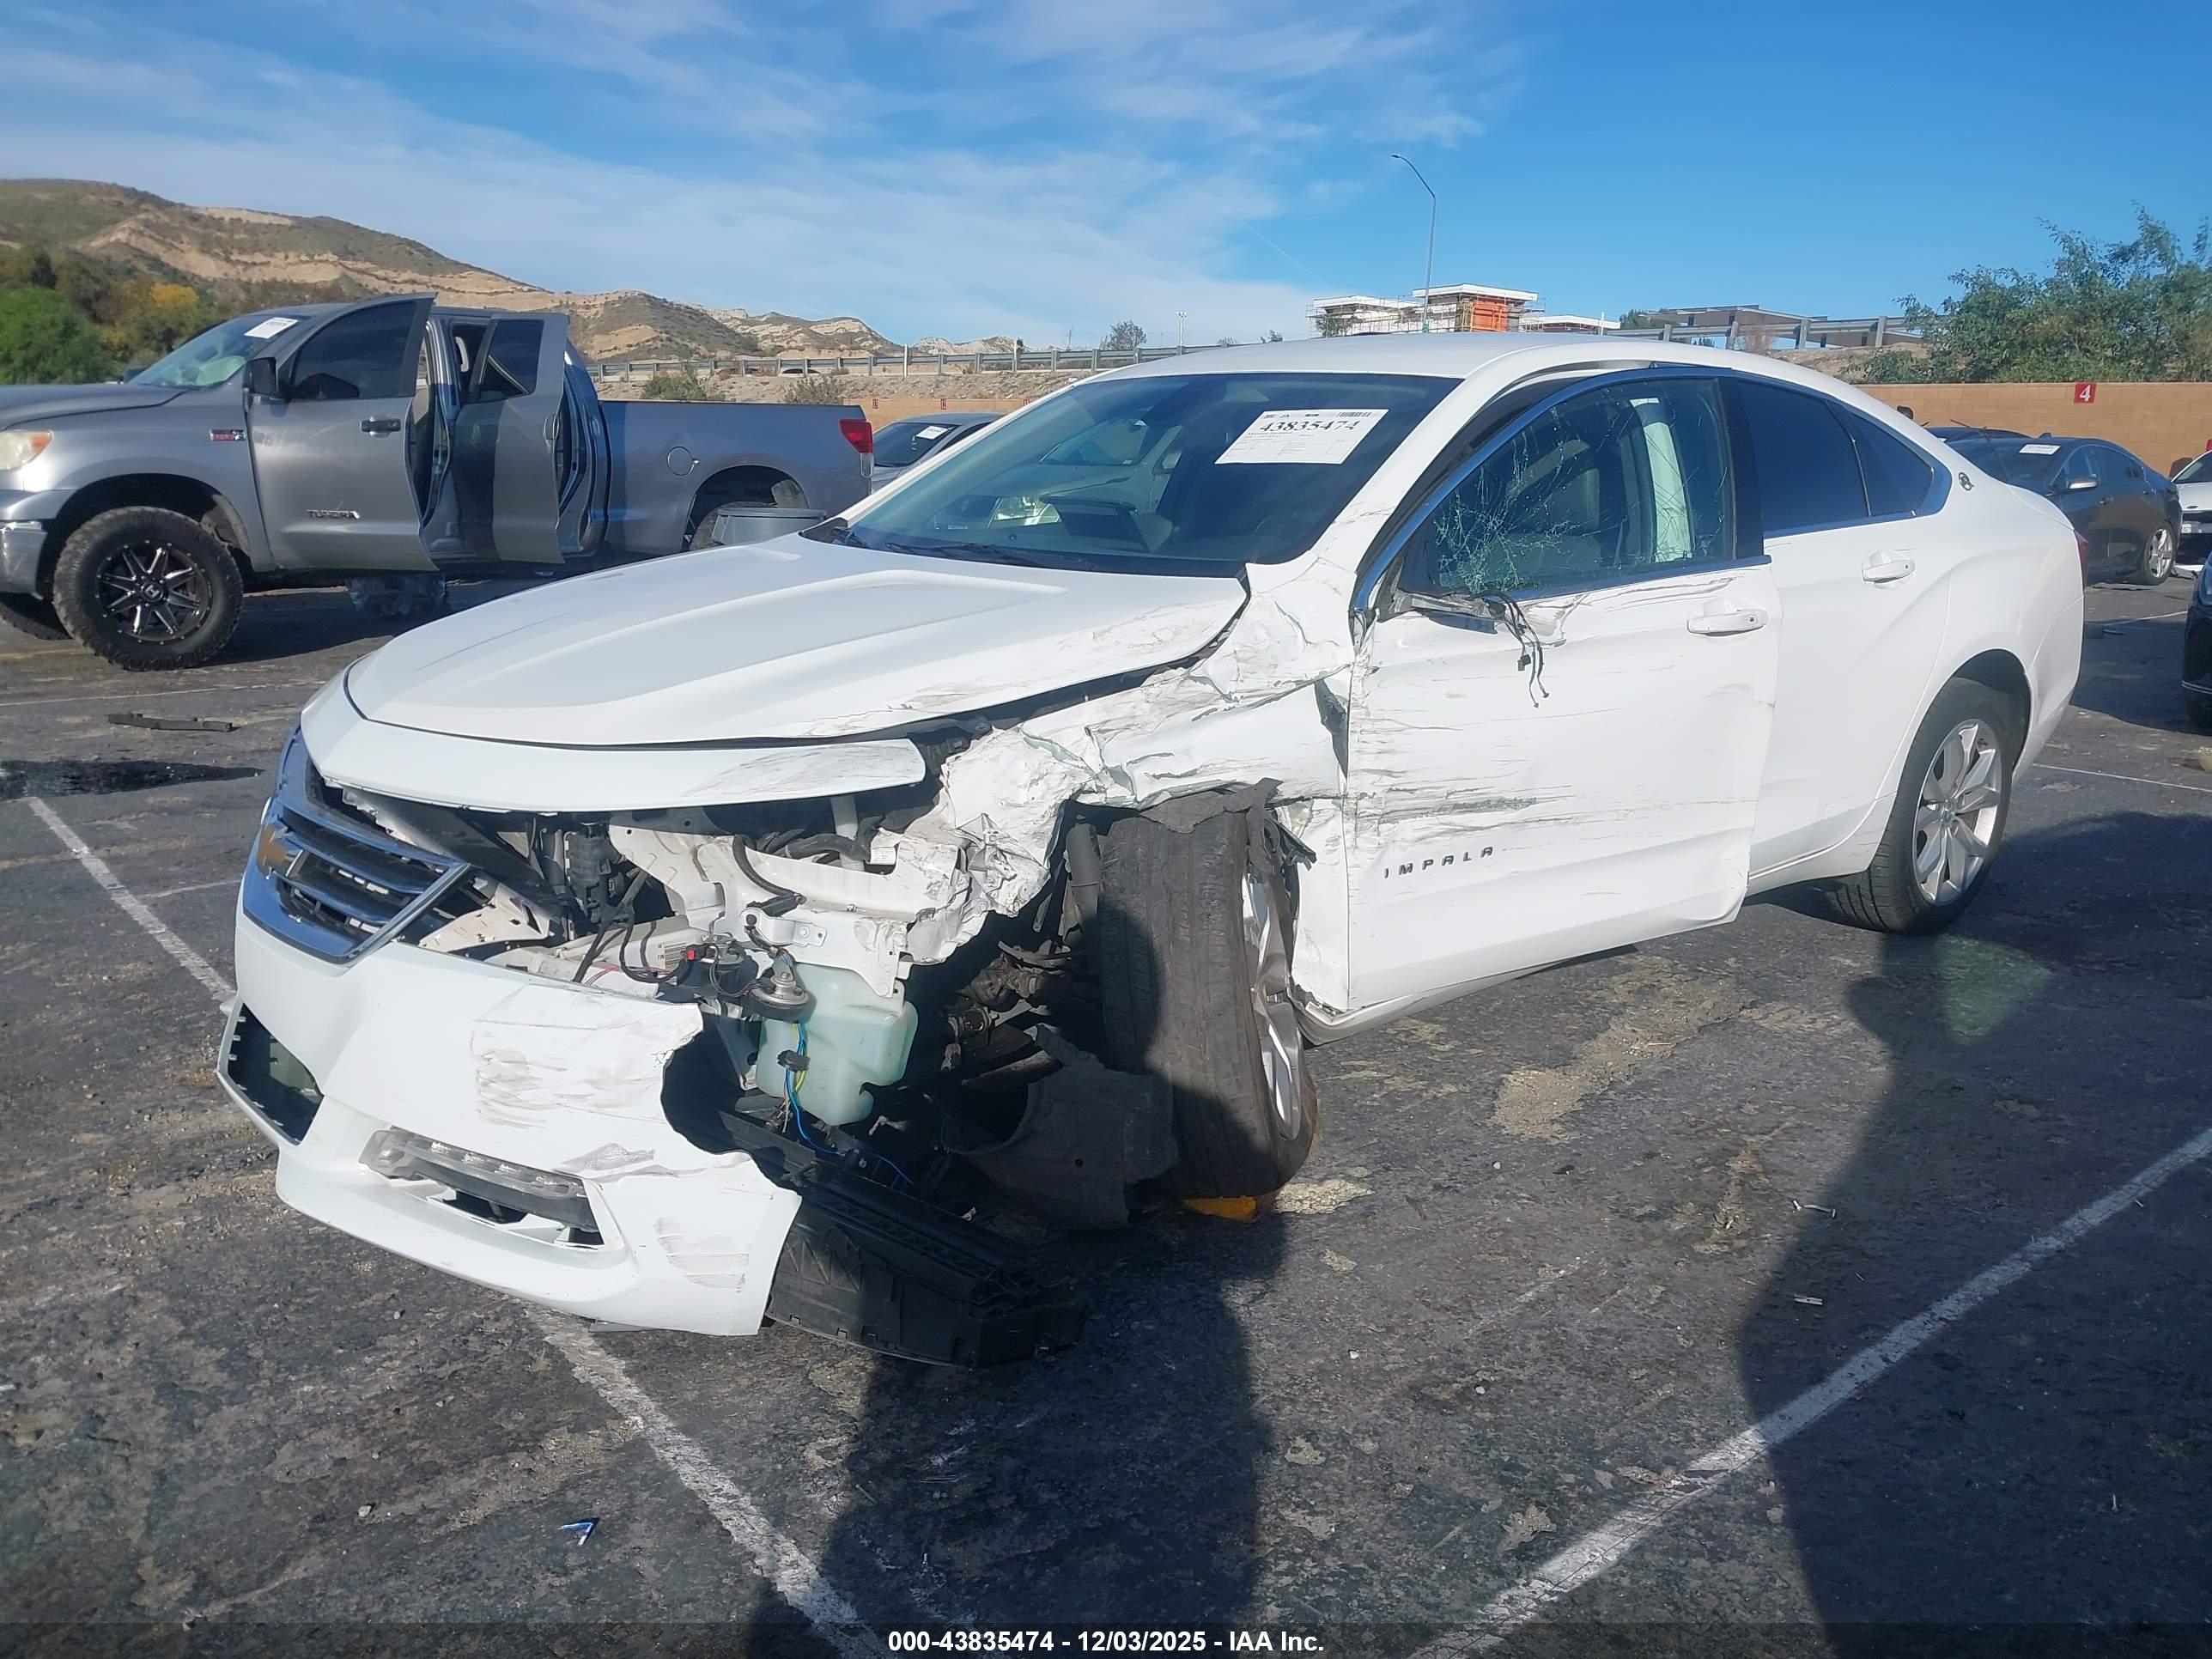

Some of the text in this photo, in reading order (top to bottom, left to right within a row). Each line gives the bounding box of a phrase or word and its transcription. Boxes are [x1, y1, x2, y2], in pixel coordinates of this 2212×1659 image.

[2079, 384, 2091, 402] 4
[1260, 420, 1361, 432] 43835474
[306, 509, 361, 520] TUNDRA
[1383, 846, 1493, 879] IMPALA
